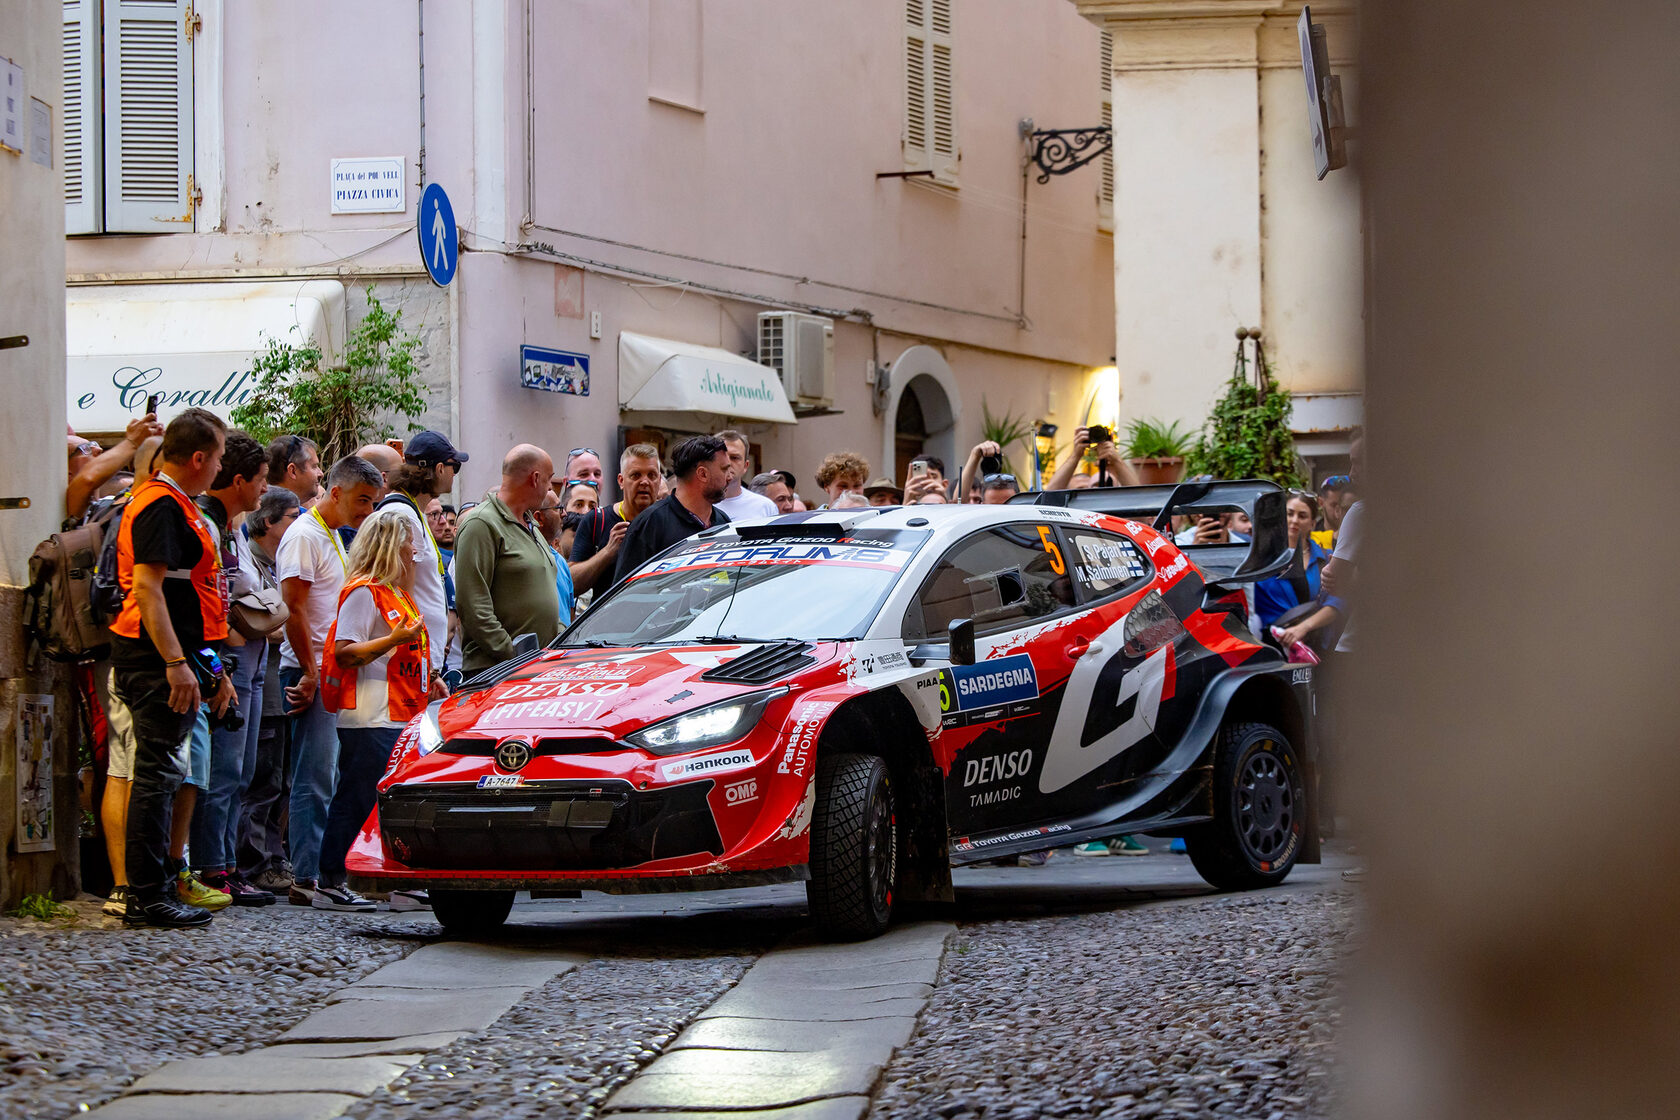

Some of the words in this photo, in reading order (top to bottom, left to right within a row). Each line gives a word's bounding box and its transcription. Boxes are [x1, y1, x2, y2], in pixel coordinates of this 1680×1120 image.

[336, 172, 355, 182] PLAÇA
[358, 172, 366, 180] del
[337, 189, 368, 200] PIAZZA
[371, 188, 399, 199] CIVICA
[77, 392, 96, 410] e
[714, 538, 774, 549] TOYOTA
[837, 537, 895, 548] Racing
[1036, 525, 1065, 575] 5
[496, 682, 630, 700] DENSO
[917, 677, 938, 690] PIAA
[959, 668, 1033, 696] SARDEGNA
[777, 702, 819, 774] Panasonic
[793, 702, 834, 777] AUTOMOTIVE
[685, 755, 751, 773] HANKOOK
[963, 748, 1033, 787] DENSO
[485, 777, 517, 787] A-7647
[725, 782, 757, 802] OMP
[970, 786, 1021, 807] TAMADIC
[972, 836, 1009, 847] TOYOTA
[1008, 829, 1041, 840] GAZOO
[1040, 824, 1072, 834] Racing
